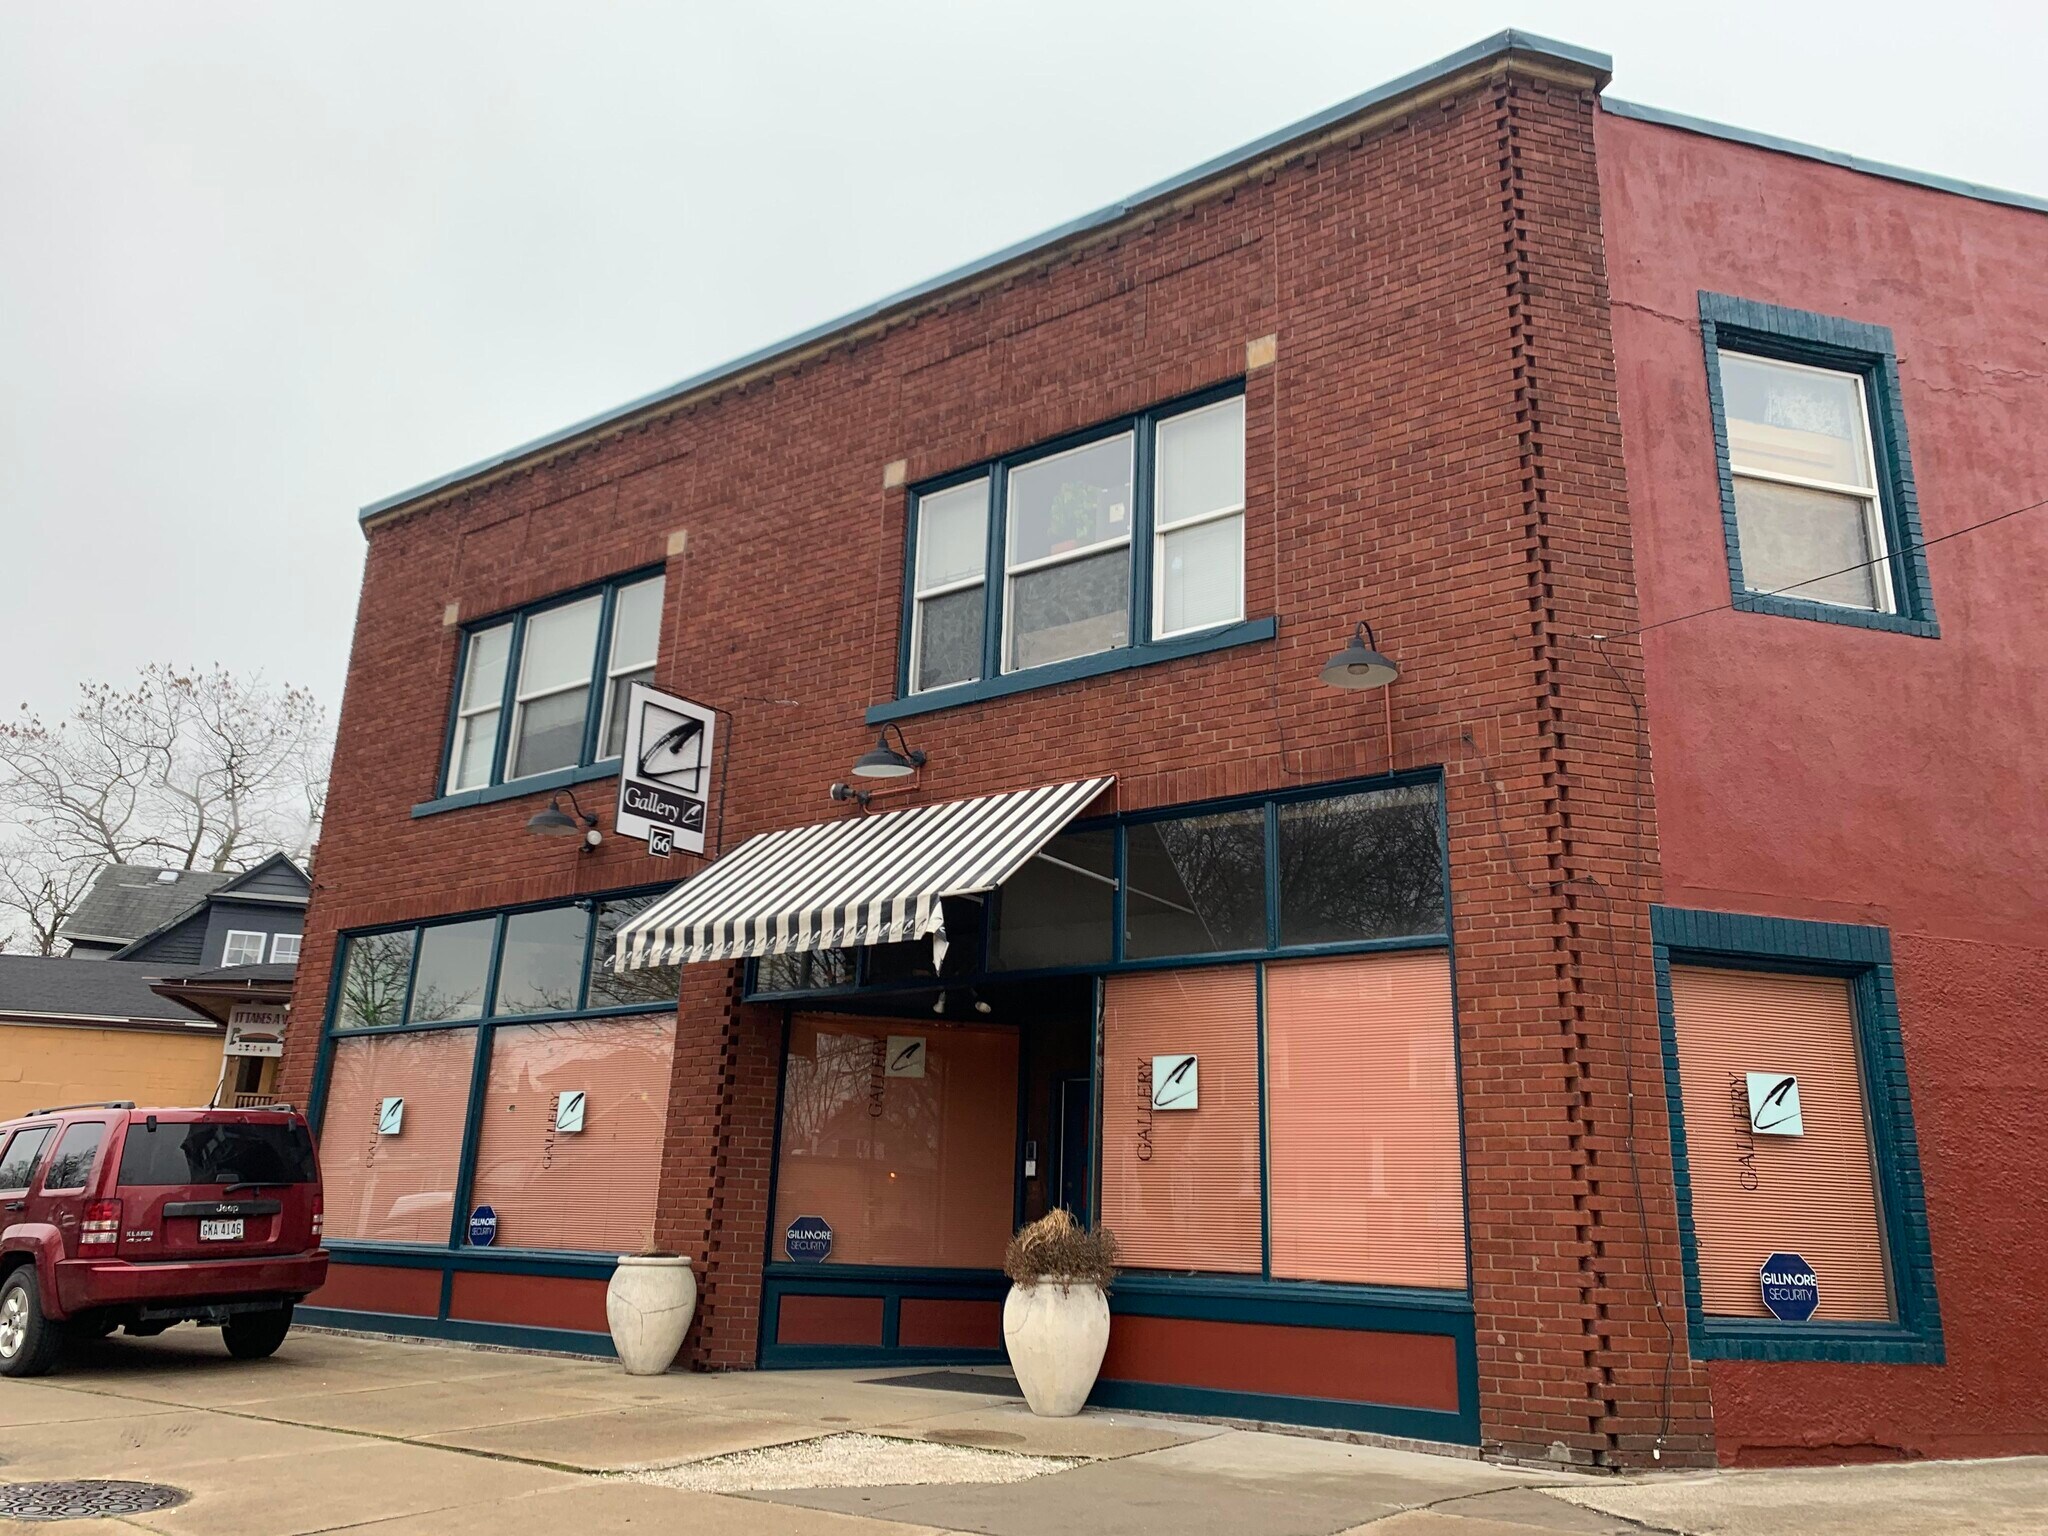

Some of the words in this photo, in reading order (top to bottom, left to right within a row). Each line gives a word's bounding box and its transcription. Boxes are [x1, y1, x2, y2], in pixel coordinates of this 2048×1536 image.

[624, 787, 680, 823] Gallery
[653, 836, 671, 853] 66
[868, 1035, 887, 1118] GALLERY
[1136, 1057, 1153, 1161] GALLERY
[542, 1092, 559, 1170] GALLERY
[1728, 1072, 1759, 1191] GALLERY
[216, 1203, 239, 1213] Jeep
[470, 1217, 497, 1226] GILLMORE
[202, 1224, 218, 1236] GKA
[221, 1223, 242, 1236] 4146
[471, 1227, 493, 1236] SECURITY
[787, 1229, 832, 1240] GILLMORE
[791, 1240, 827, 1251] SECURITY
[1762, 1272, 1816, 1287] GILLMORE
[1769, 1287, 1813, 1302] SECURITY
